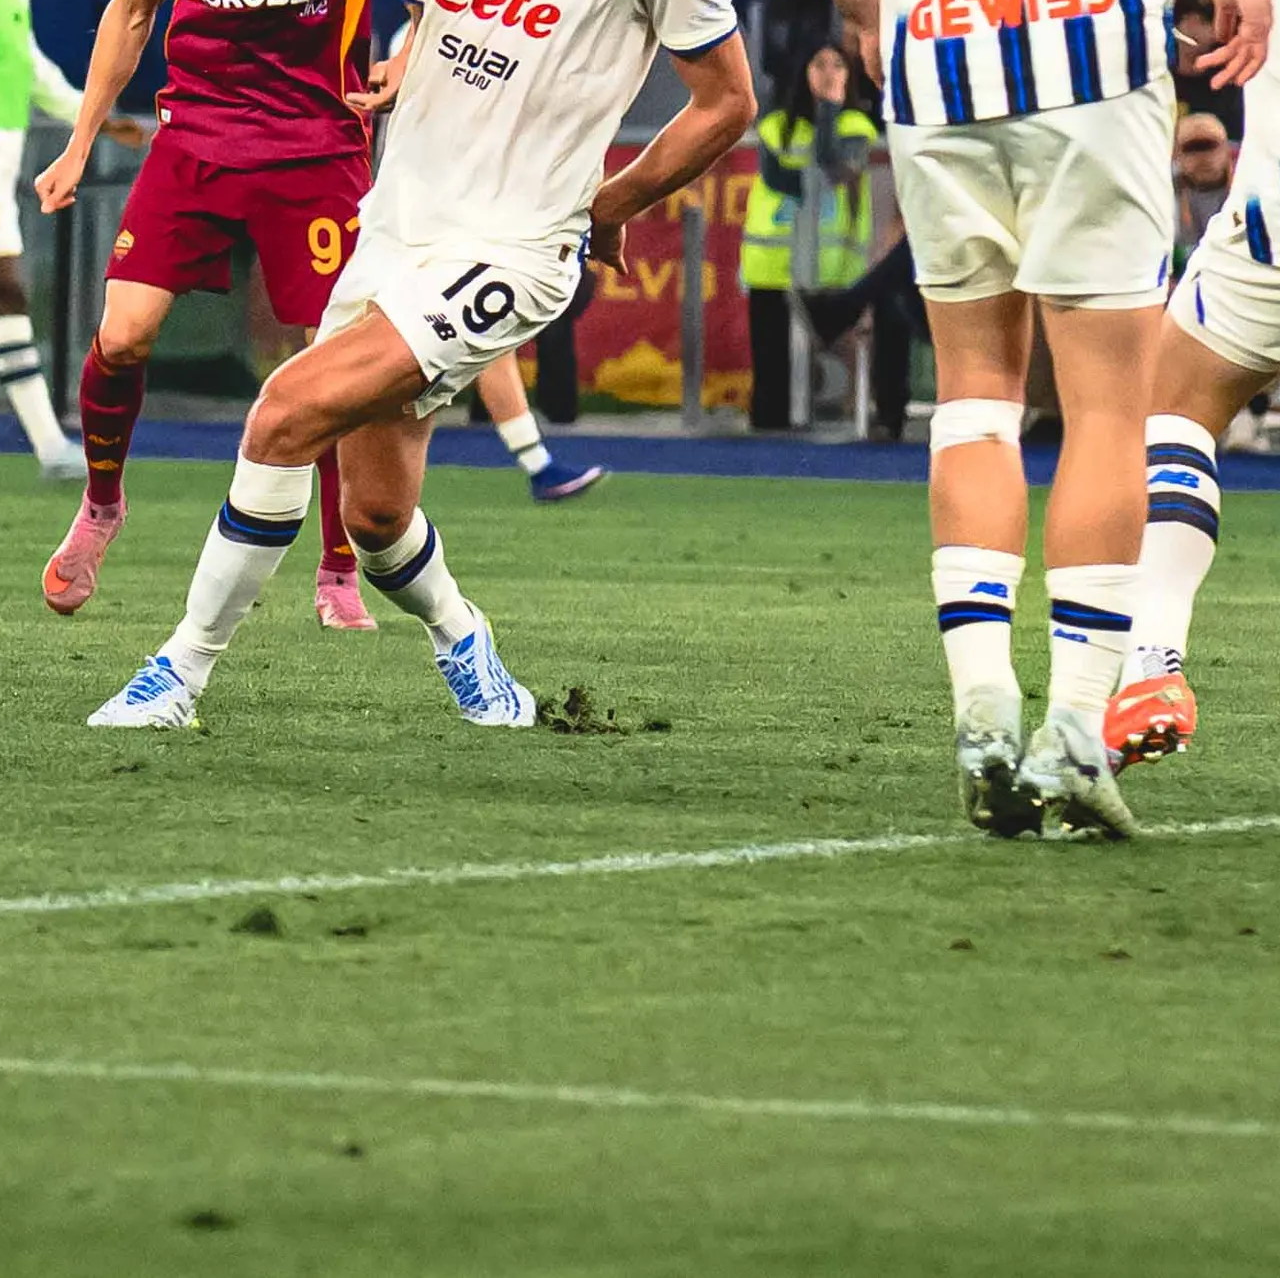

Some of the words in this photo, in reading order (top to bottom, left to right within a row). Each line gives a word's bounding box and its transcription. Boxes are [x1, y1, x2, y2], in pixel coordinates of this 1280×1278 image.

[452, 66, 492, 91] FUN
[307, 216, 361, 276] 9
[441, 262, 515, 334] 19
